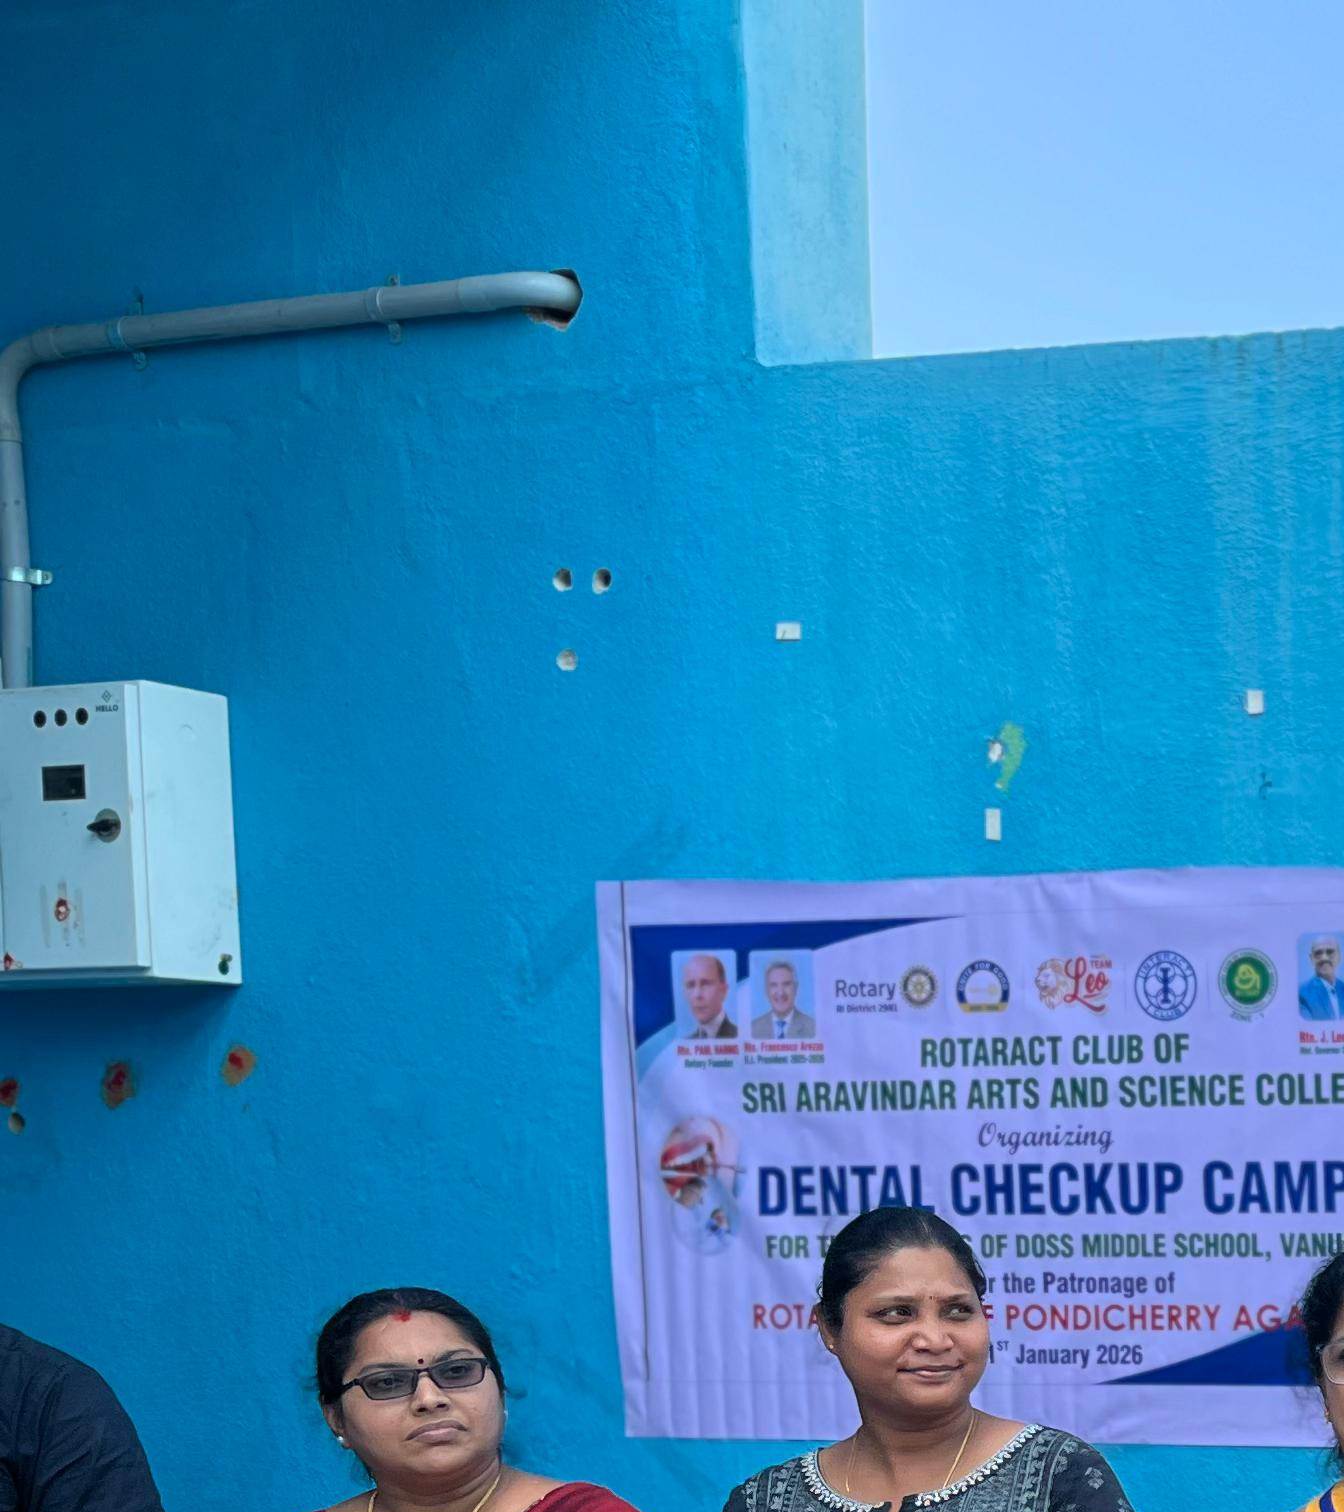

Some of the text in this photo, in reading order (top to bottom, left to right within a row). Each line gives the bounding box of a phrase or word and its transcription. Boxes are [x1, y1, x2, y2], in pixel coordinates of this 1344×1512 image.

[1090, 960, 1112, 969] TEAM
[835, 979, 896, 1000] Rotary
[1064, 956, 1108, 1012] Leo
[847, 1004, 877, 1013] District
[921, 1033, 1190, 1068] ROTARACT CLUB OF
[742, 1083, 786, 1113] SRI
[796, 1079, 957, 1113] ARAVINDAR
[966, 1078, 1040, 1110] ARTS
[1050, 1076, 1109, 1108] AND
[1119, 1074, 1245, 1107] SCIENCE
[978, 1121, 1114, 1155] Organizing
[758, 1164, 935, 1216] DENTAL
[950, 1161, 1183, 1216] CHECKUP
[766, 1235, 810, 1258] FOR
[981, 1234, 1008, 1258] OF
[1016, 1233, 1074, 1258] DOSS
[1082, 1233, 1166, 1258] MIDDLE
[1174, 1232, 1272, 1261] SCHOOL,
[1003, 1272, 1036, 1294] the
[1042, 1272, 1148, 1298] Patronage
[1154, 1272, 1175, 1293] of
[753, 1303, 817, 1329] ROTA
[1006, 1303, 1221, 1331] PONDICHERRY
[1232, 1304, 1304, 1332] AGA
[1016, 1344, 1090, 1368] January
[1096, 1344, 1144, 1366] 2026
